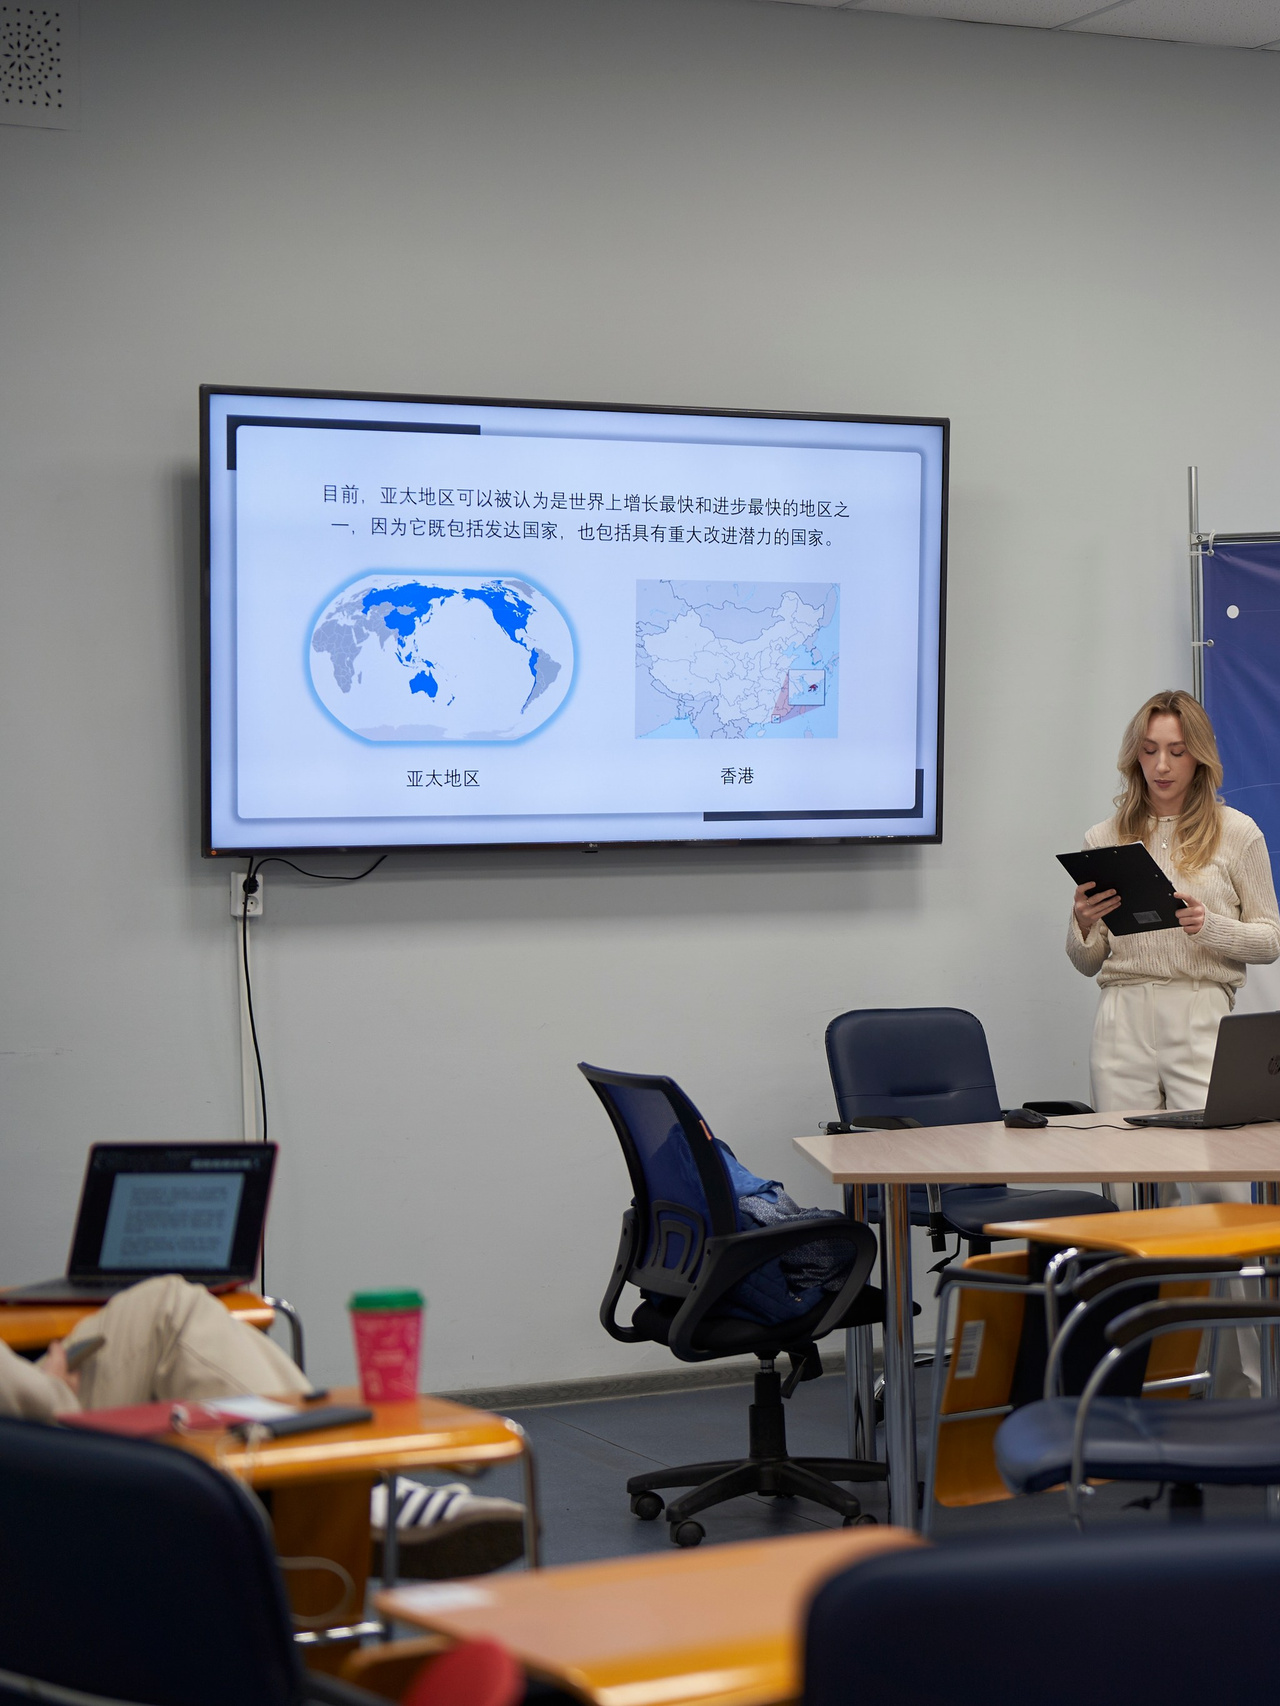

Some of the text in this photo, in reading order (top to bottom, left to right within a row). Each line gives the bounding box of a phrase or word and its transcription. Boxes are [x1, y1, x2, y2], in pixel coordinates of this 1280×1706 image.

[406, 769, 481, 788] 亚太地区
[720, 766, 755, 785] 香港
